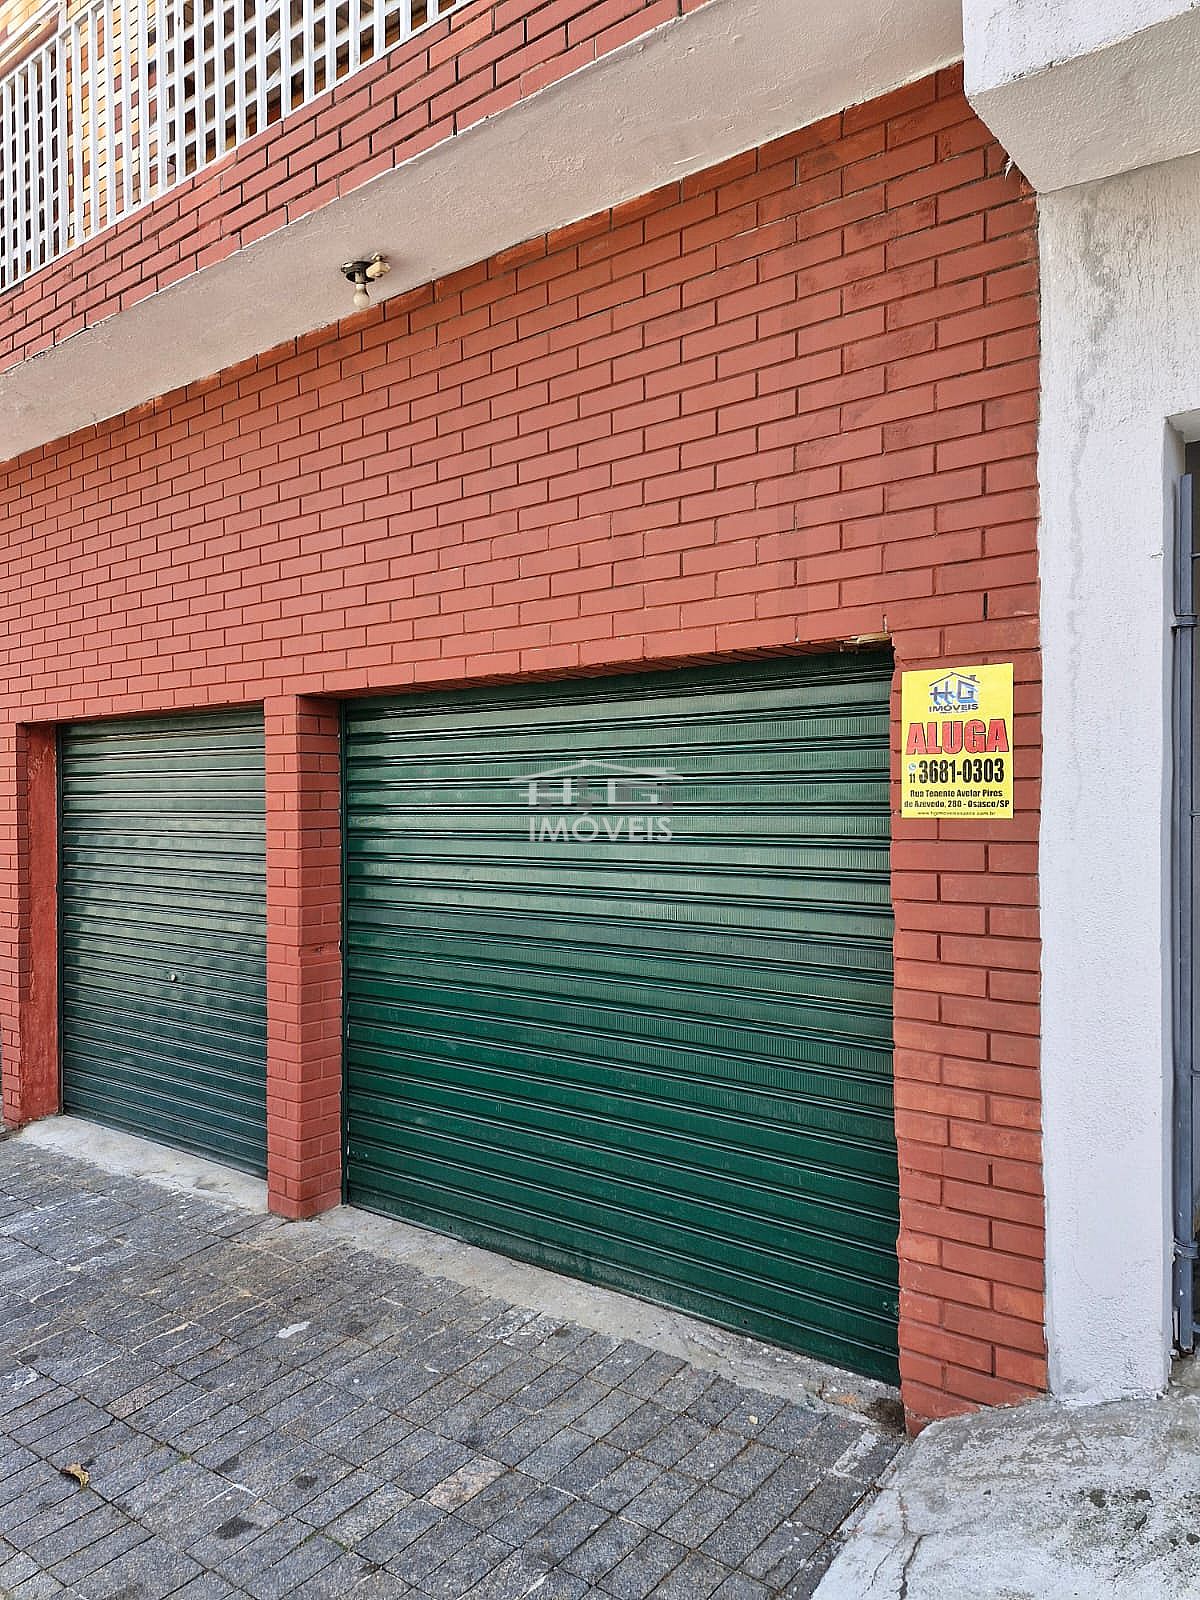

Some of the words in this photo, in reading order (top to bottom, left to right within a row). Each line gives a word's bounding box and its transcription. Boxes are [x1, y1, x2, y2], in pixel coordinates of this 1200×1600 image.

[905, 718, 1010, 755] ALUGA
[908, 773, 916, 784] 11
[918, 758, 1005, 784] 3681-0303
[910, 789, 925, 798] Rua
[925, 789, 956, 798] Tenente
[982, 788, 1004, 798] Pires
[904, 800, 914, 808] de
[947, 800, 962, 808] 280
[967, 799, 1010, 808] Osasco/SP
